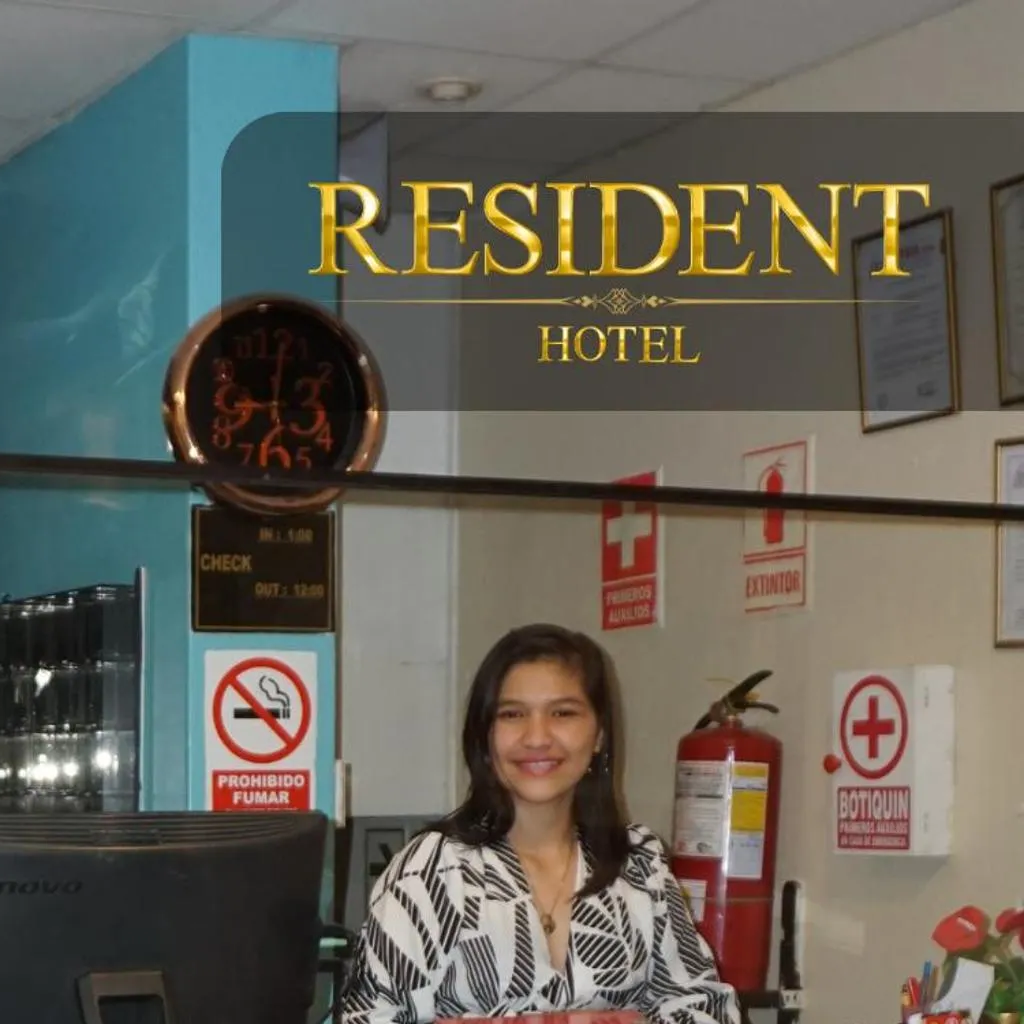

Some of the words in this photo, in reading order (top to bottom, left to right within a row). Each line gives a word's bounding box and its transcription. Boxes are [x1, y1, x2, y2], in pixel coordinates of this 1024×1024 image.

[288, 376, 328, 436] 3
[314, 421, 334, 453] 4
[200, 553, 253, 573] CHECK
[746, 570, 801, 599] EXTINTOR
[218, 773, 306, 789] PROHIBIDO
[232, 790, 290, 805] FUMAR
[839, 788, 909, 819] BOTIQUIN
